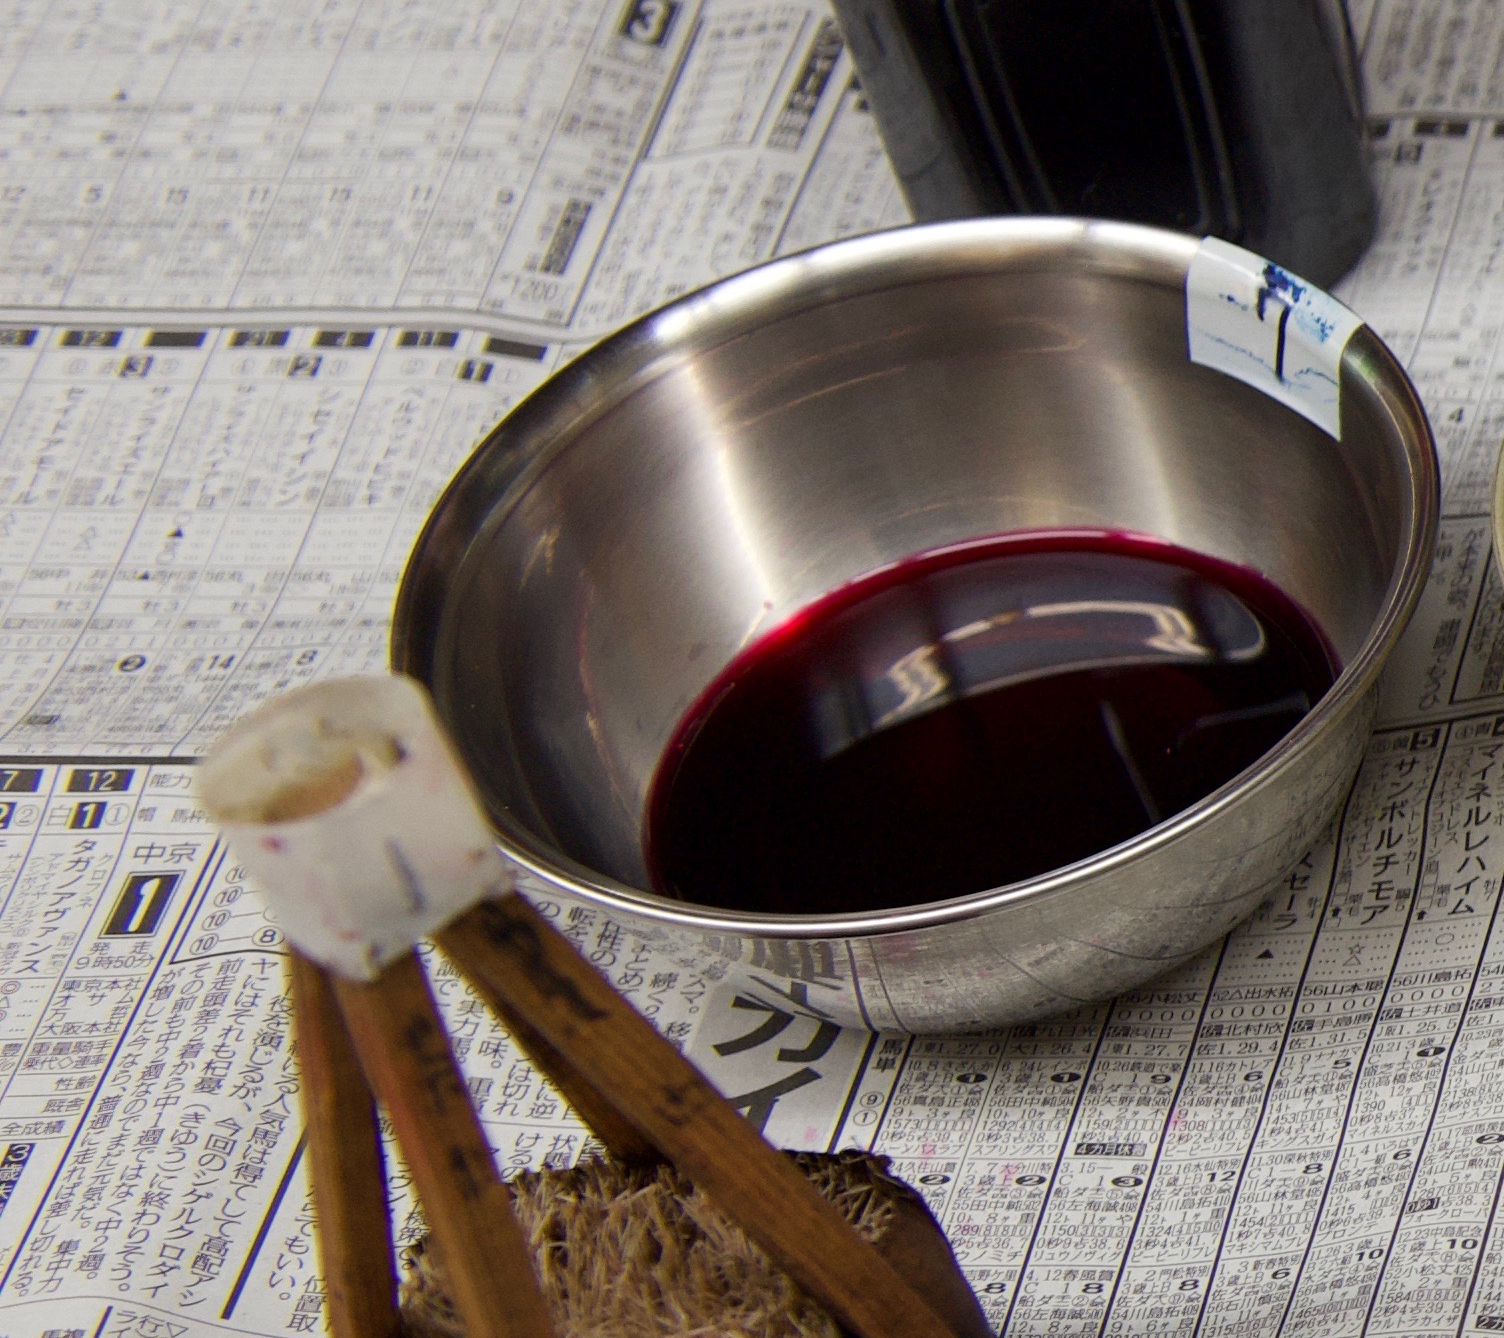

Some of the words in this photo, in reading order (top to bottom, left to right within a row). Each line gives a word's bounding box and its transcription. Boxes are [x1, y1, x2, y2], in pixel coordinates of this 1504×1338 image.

[87, 771, 117, 792] 12
[133, 841, 201, 865] 中京
[60, 977, 144, 993] 東京本社
[38, 1021, 122, 1037] 大阪本社
[1, 1120, 66, 1136] 全成績
